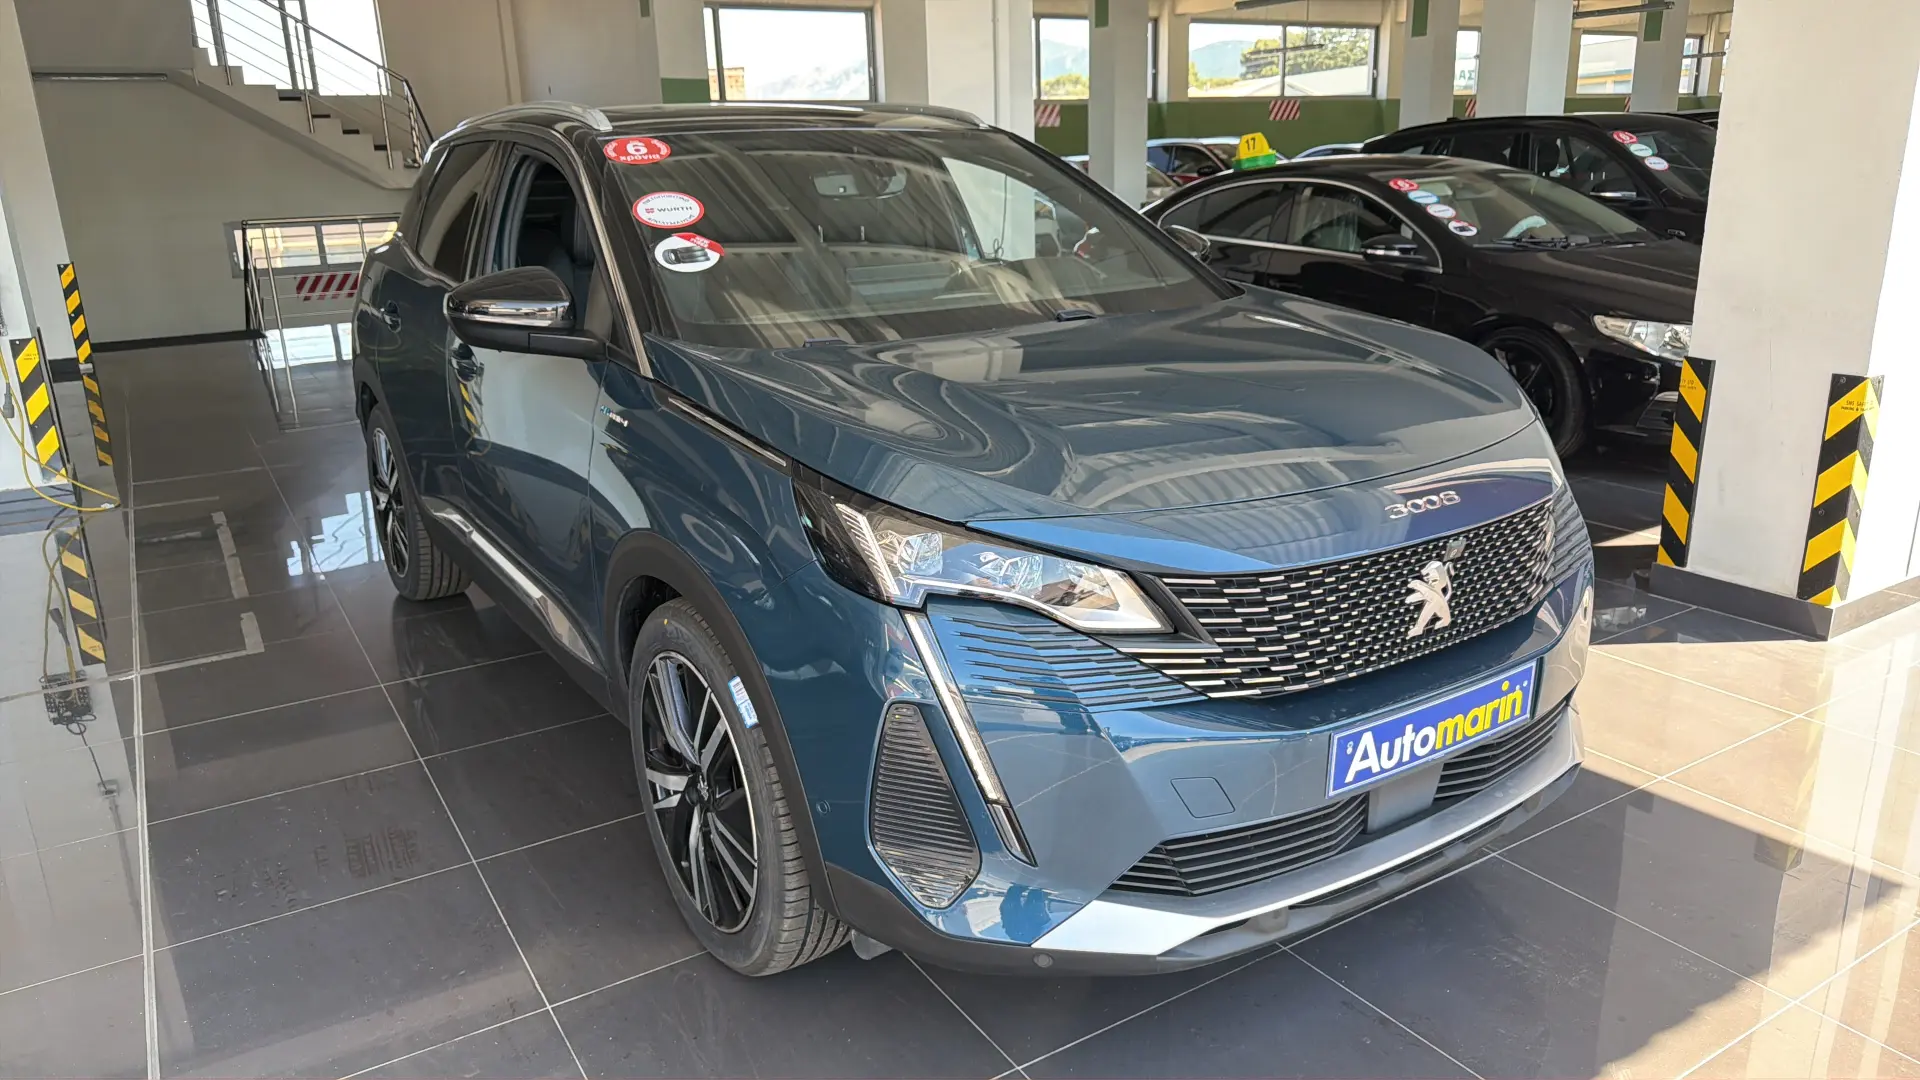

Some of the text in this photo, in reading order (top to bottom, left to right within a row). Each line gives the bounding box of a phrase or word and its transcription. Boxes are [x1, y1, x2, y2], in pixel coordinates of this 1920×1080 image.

[626, 140, 648, 155] 6
[1245, 137, 1256, 152] 17
[1344, 680, 1523, 784] Automarin
